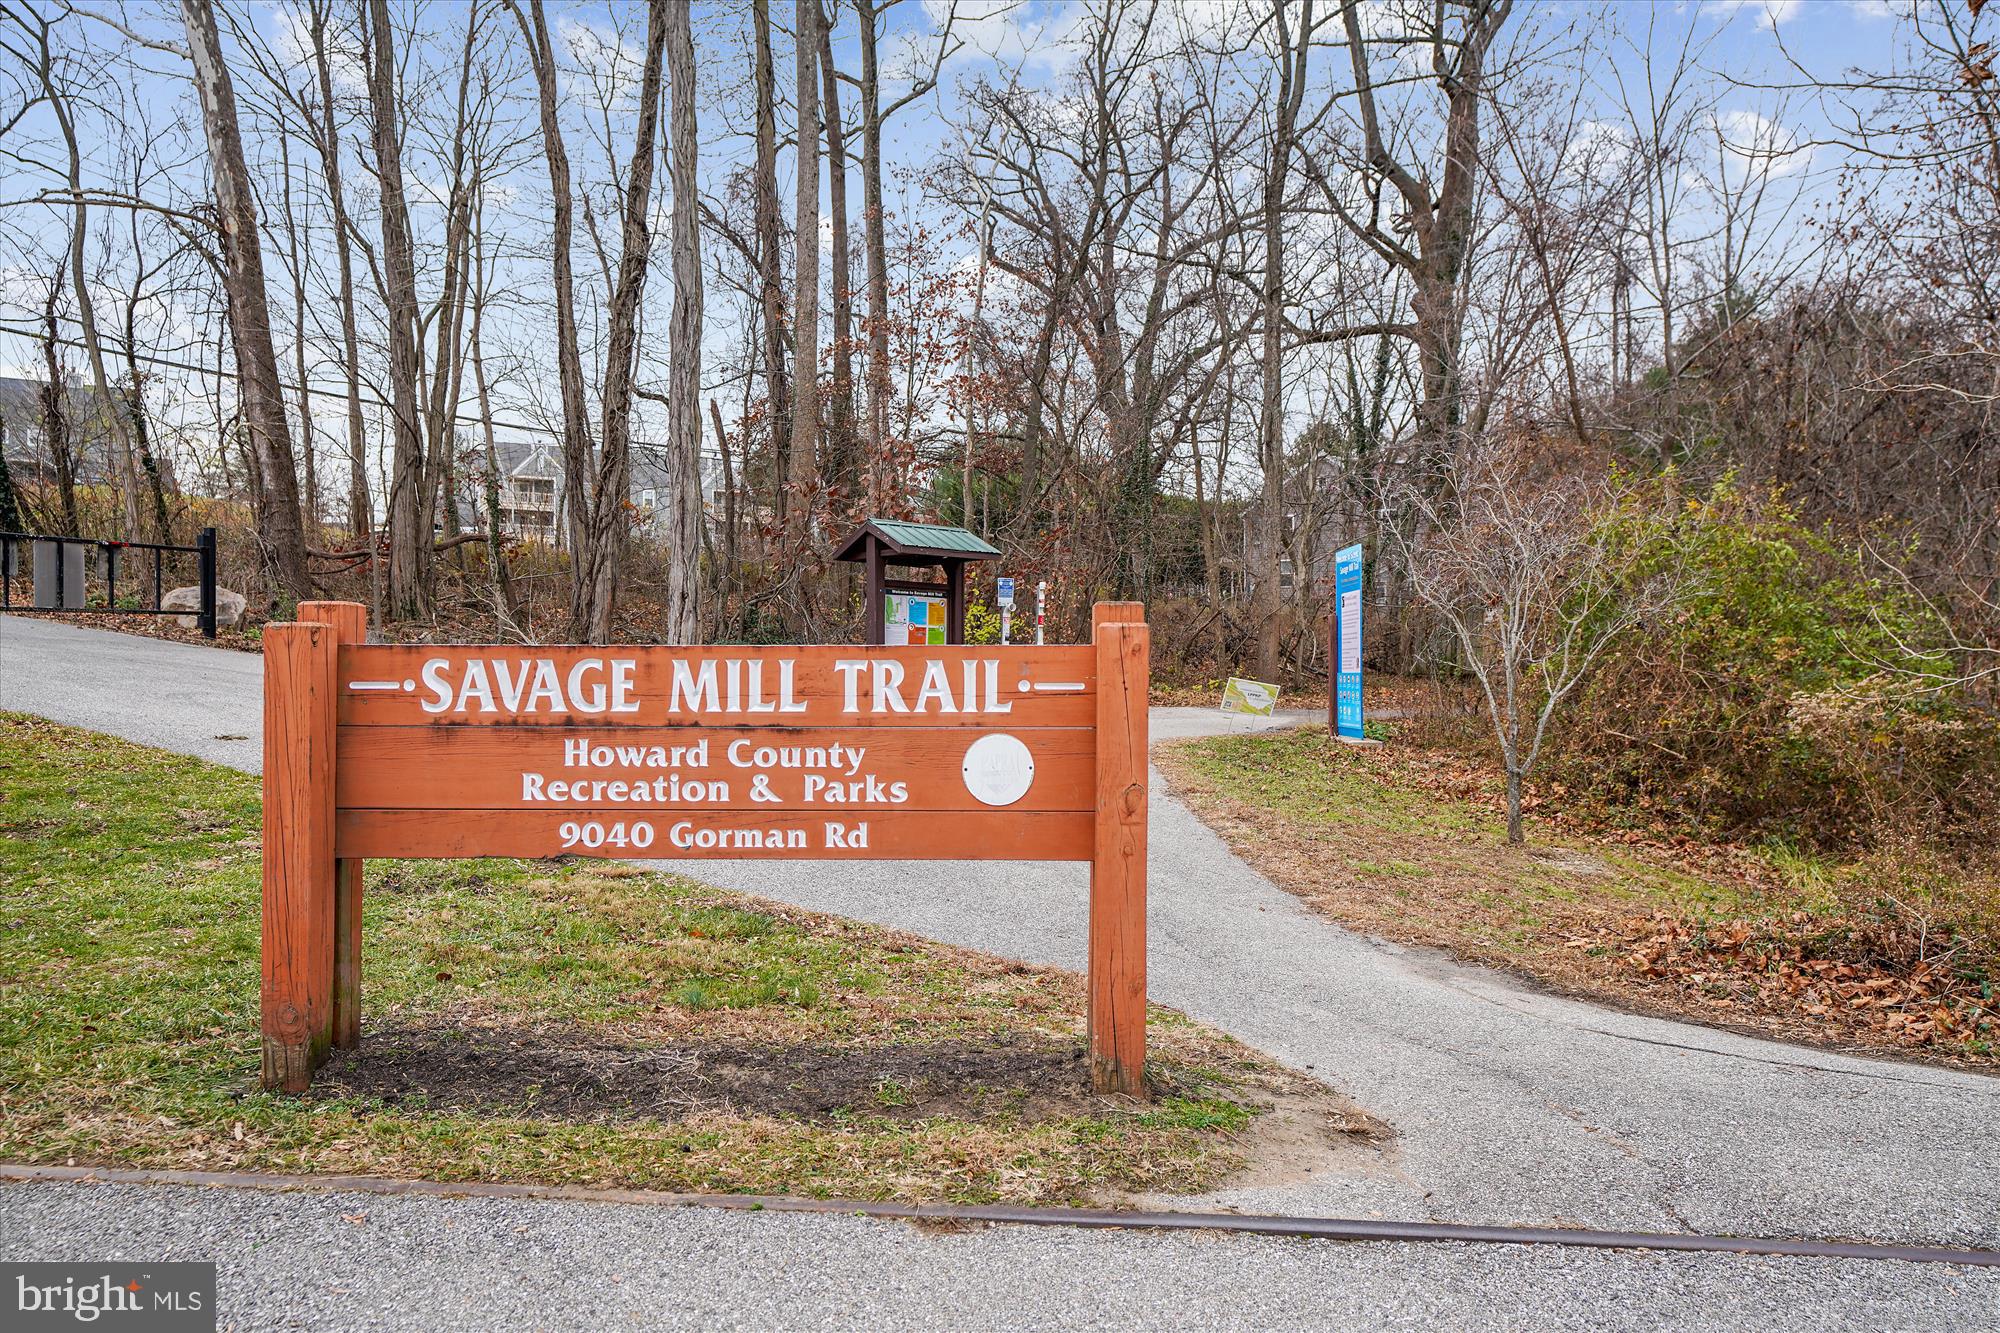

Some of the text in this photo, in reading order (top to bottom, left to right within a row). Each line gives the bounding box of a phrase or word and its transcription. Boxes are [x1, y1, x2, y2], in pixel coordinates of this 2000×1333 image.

[420, 657, 1013, 715] SAVAGE MILL TRAIL
[563, 738, 866, 776] Howard County
[521, 772, 909, 804] Recreation & Parks
[558, 821, 869, 850] 9040 Gorman Rd
